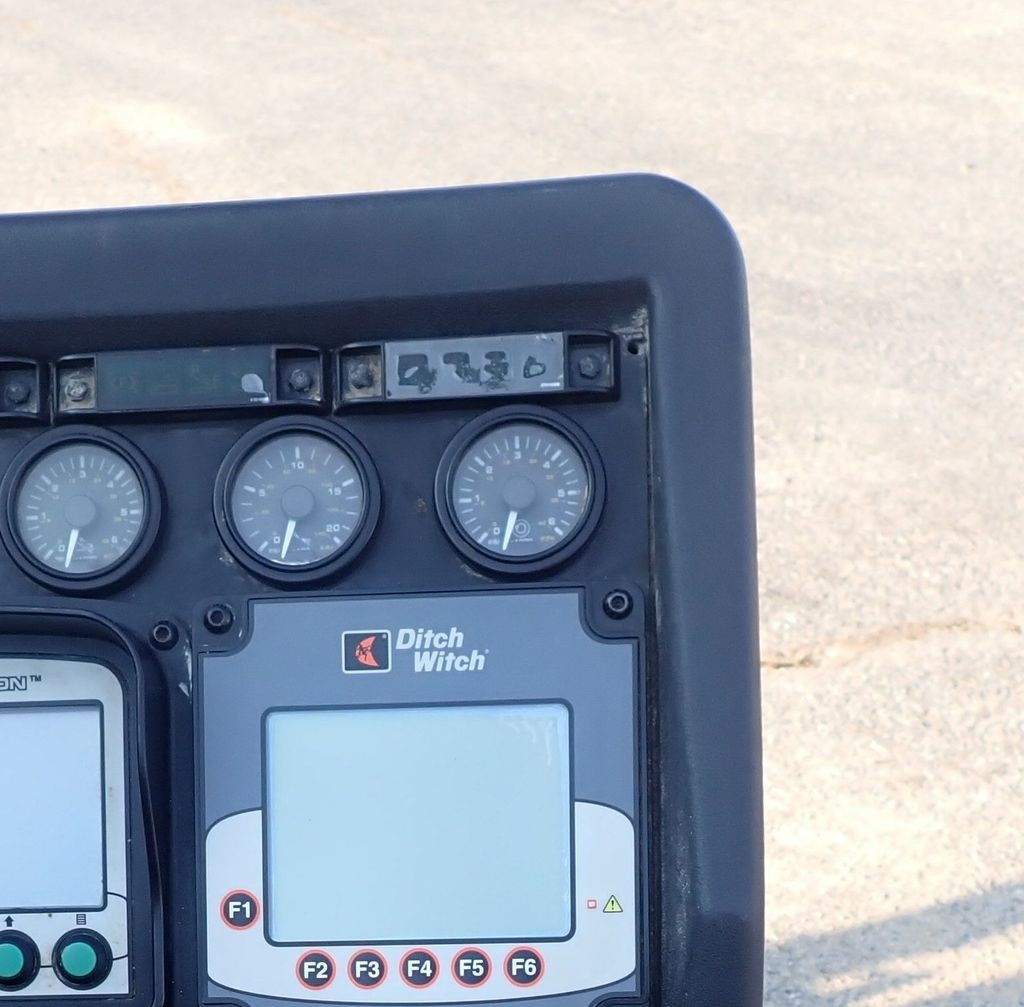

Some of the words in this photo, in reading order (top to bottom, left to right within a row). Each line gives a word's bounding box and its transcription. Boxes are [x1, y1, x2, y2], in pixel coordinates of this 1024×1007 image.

[291, 461, 305, 470] 10
[328, 487, 342, 496] 15
[326, 524, 340, 532] 20
[396, 627, 464, 649] Ditch
[414, 650, 485, 672] Witch
[228, 901, 251, 918] F1
[303, 961, 328, 979] F2
[355, 960, 380, 978] F3
[407, 959, 432, 977] F4
[459, 959, 484, 977] F5
[511, 958, 537, 976] F6
